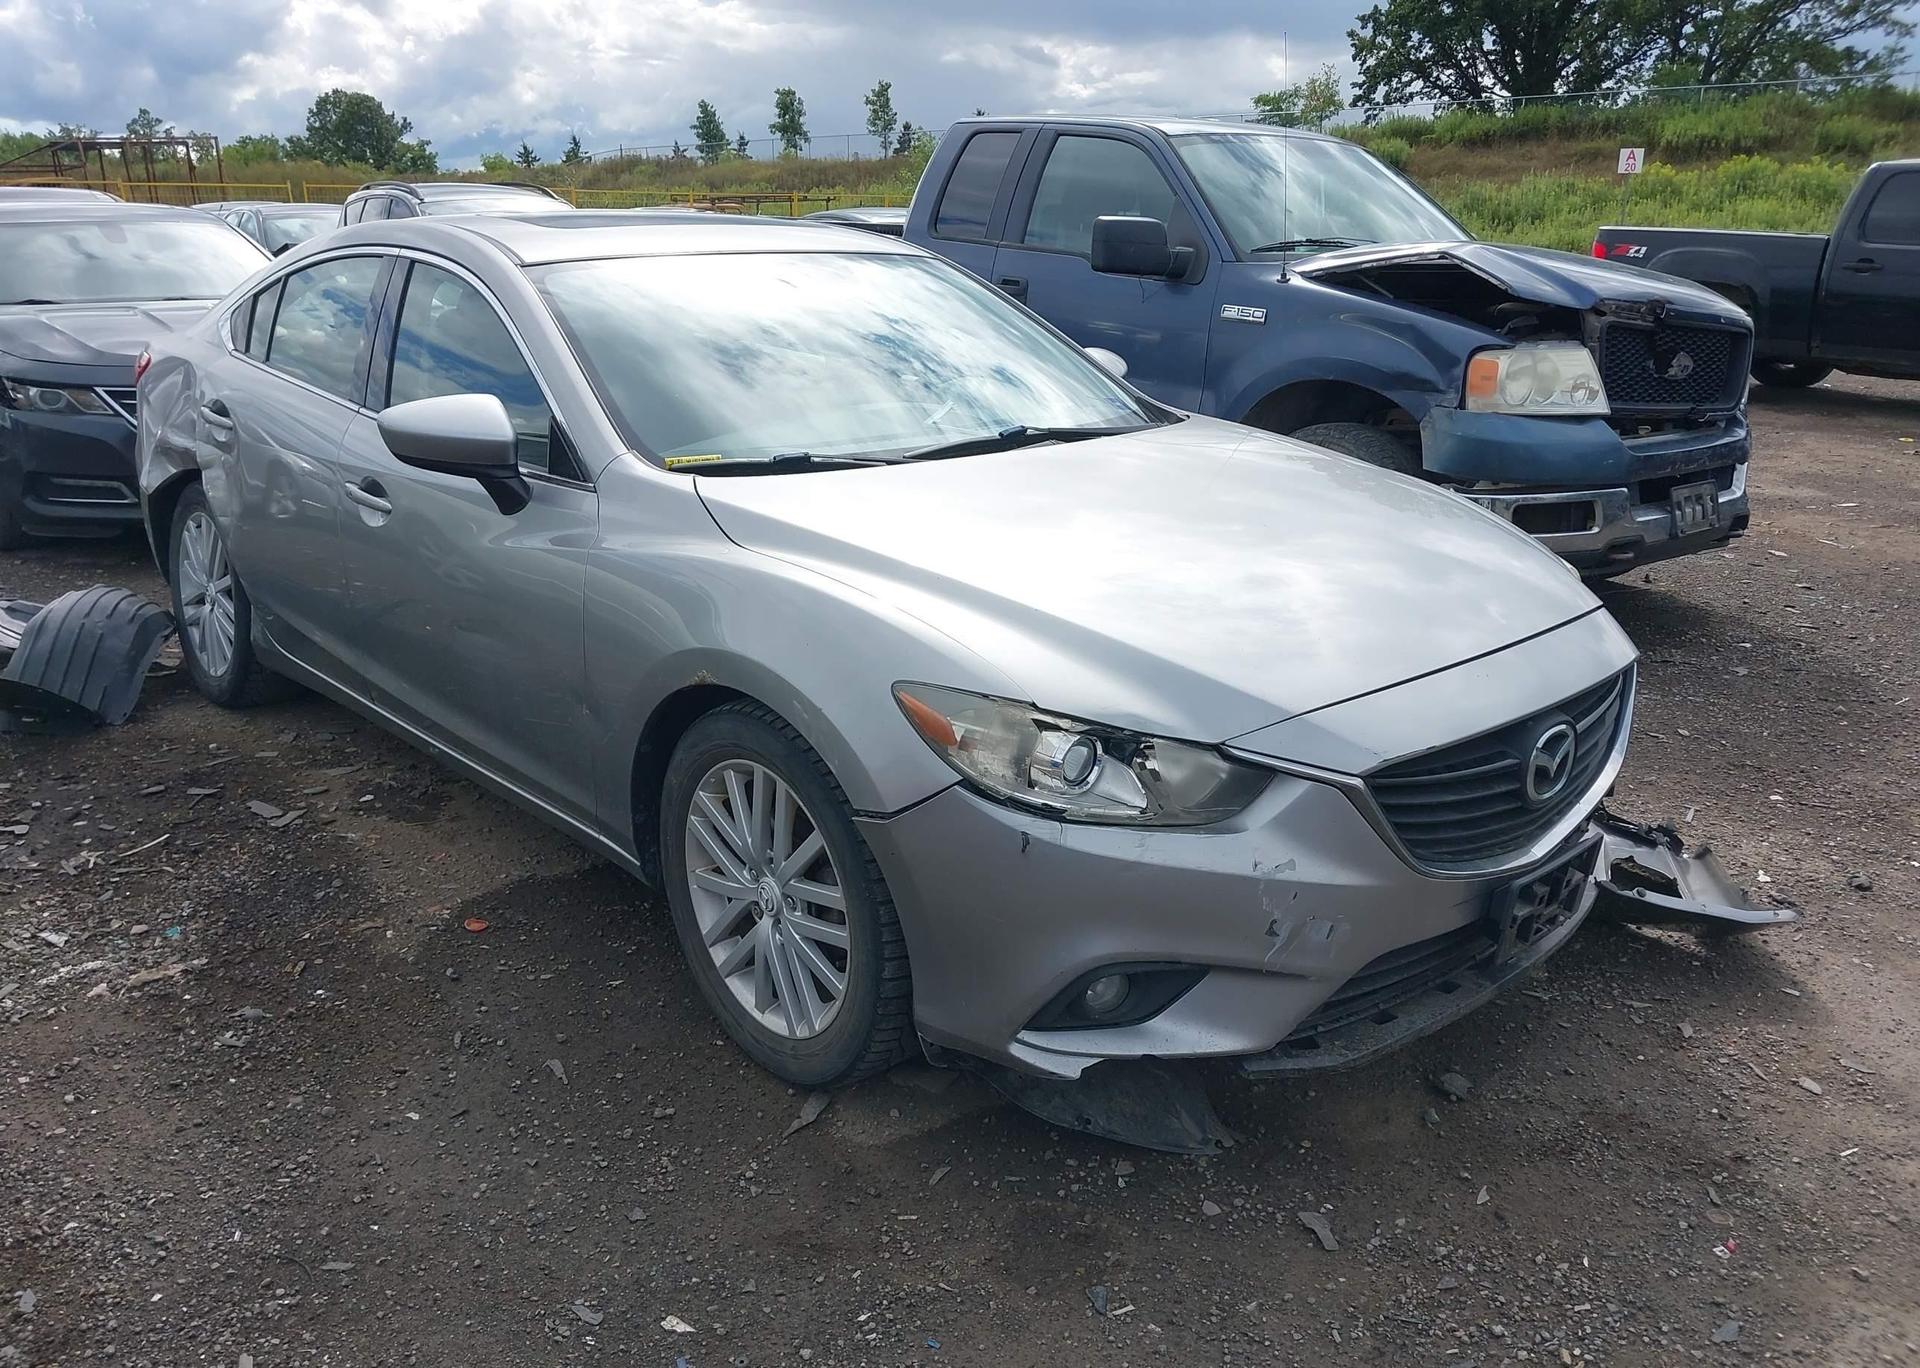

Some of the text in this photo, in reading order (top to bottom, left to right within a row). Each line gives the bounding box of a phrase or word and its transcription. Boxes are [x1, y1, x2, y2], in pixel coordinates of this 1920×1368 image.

[1626, 149, 1637, 162] A
[1624, 162, 1637, 172] 20
[1221, 305, 1265, 319] F-150
